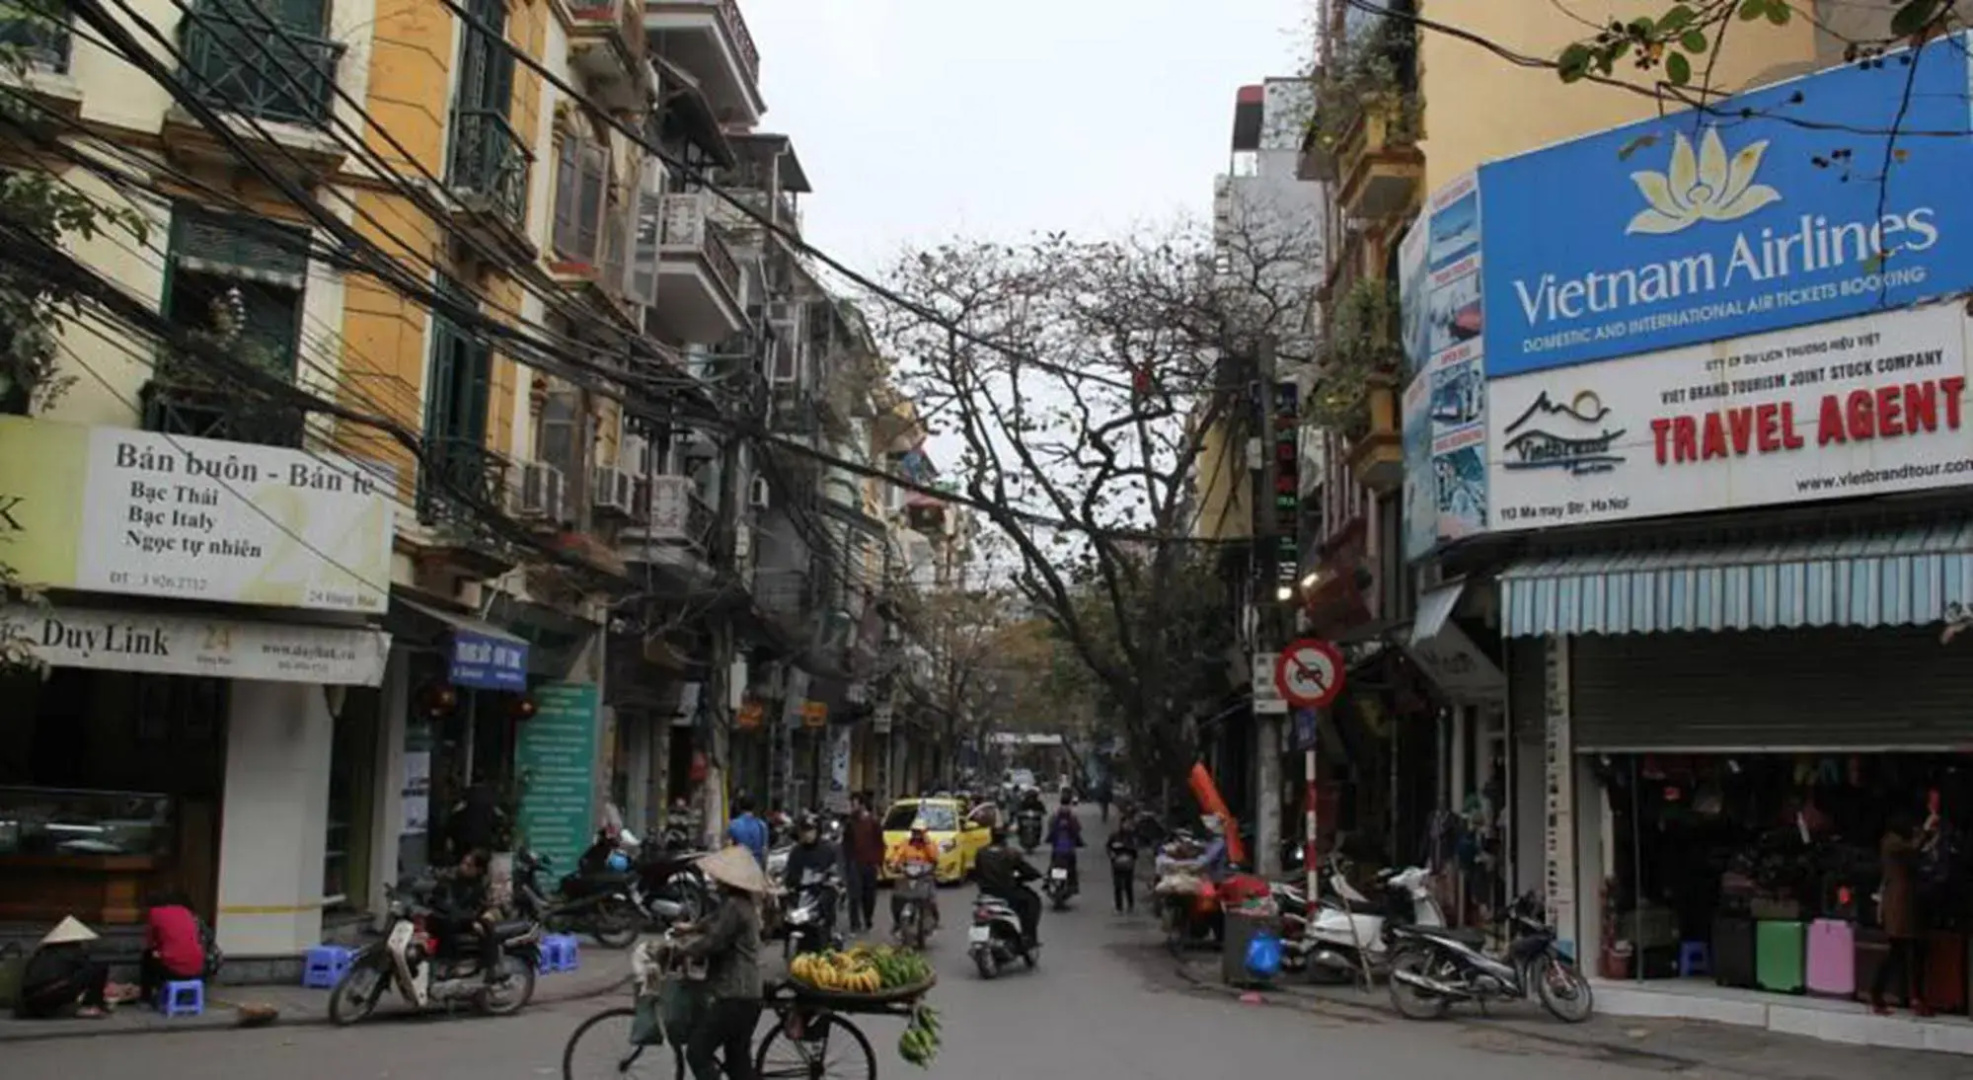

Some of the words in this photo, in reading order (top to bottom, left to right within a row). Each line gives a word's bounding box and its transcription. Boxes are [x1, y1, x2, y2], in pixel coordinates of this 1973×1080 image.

[1512, 251, 1715, 328] Vietnam
[1723, 207, 1939, 287] Airlines
[1523, 328, 1592, 353] DOMESTIC
[1595, 322, 1626, 339] AND
[1629, 302, 1743, 334] INTERNATIONAL
[1747, 293, 1773, 312] AIR
[1777, 282, 1837, 307] TICKETS
[1660, 388, 1686, 405] VIET
[1689, 381, 1729, 401] BRAND
[1731, 374, 1786, 395] TOURISM
[1789, 367, 1825, 386] JOINT
[1830, 359, 1873, 380] STOCK
[1877, 349, 1943, 374] COMPANY
[1650, 401, 1805, 466] TRAVEL
[1817, 376, 1965, 448] AGENT
[116, 443, 174, 472] Bán
[186, 451, 258, 482] buôn
[289, 463, 342, 491] Bán
[129, 505, 165, 528] Bạc
[172, 509, 215, 533] Italy
[130, 481, 167, 503] Bạc
[174, 484, 218, 506] Thái
[126, 530, 177, 553] Ngọc
